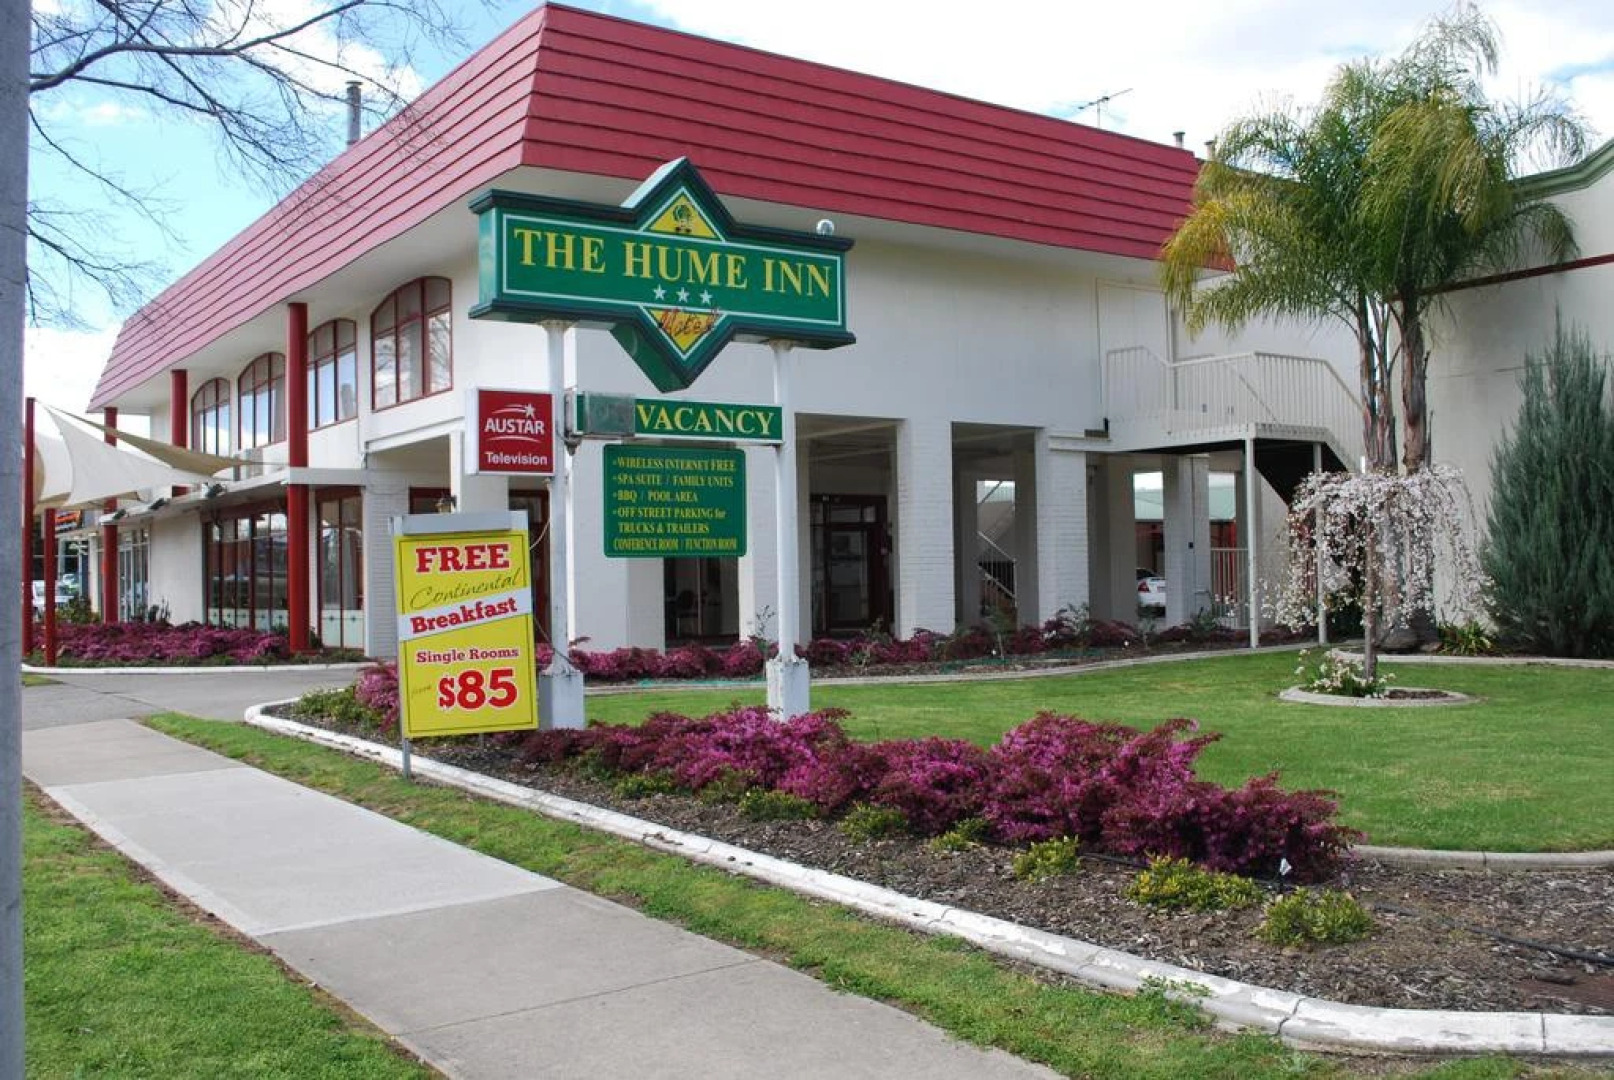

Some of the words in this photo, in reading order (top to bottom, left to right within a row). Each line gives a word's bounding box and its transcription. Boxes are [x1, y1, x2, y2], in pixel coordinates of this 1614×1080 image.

[513, 228, 606, 273] THE
[623, 241, 748, 290] HUME
[763, 258, 830, 298] INN
[484, 417, 545, 435] AUSTAR
[636, 404, 775, 435] VACANCY
[484, 451, 548, 465] Television
[618, 457, 663, 469] WIRELESS
[665, 459, 709, 470] INTERNET
[711, 460, 735, 471] FREE
[618, 474, 633, 484] SPA
[635, 475, 661, 485] SUITE
[673, 476, 705, 486] FAMILY
[707, 477, 733, 487] UNITS
[618, 491, 638, 503] BBQ
[648, 492, 671, 502] POOL
[675, 492, 698, 502] AREA
[618, 508, 636, 518] OFF
[638, 508, 672, 518] STREET
[675, 509, 713, 519] PARKING
[619, 523, 655, 533] TRUCKS
[657, 524, 663, 533] &
[666, 524, 709, 534] TRAILERS
[416, 543, 510, 572] FREE
[410, 567, 521, 610] Continental
[410, 596, 518, 635] Breakfast
[416, 650, 465, 665] Single
[470, 648, 519, 660] Rooms
[438, 667, 518, 710] $85
